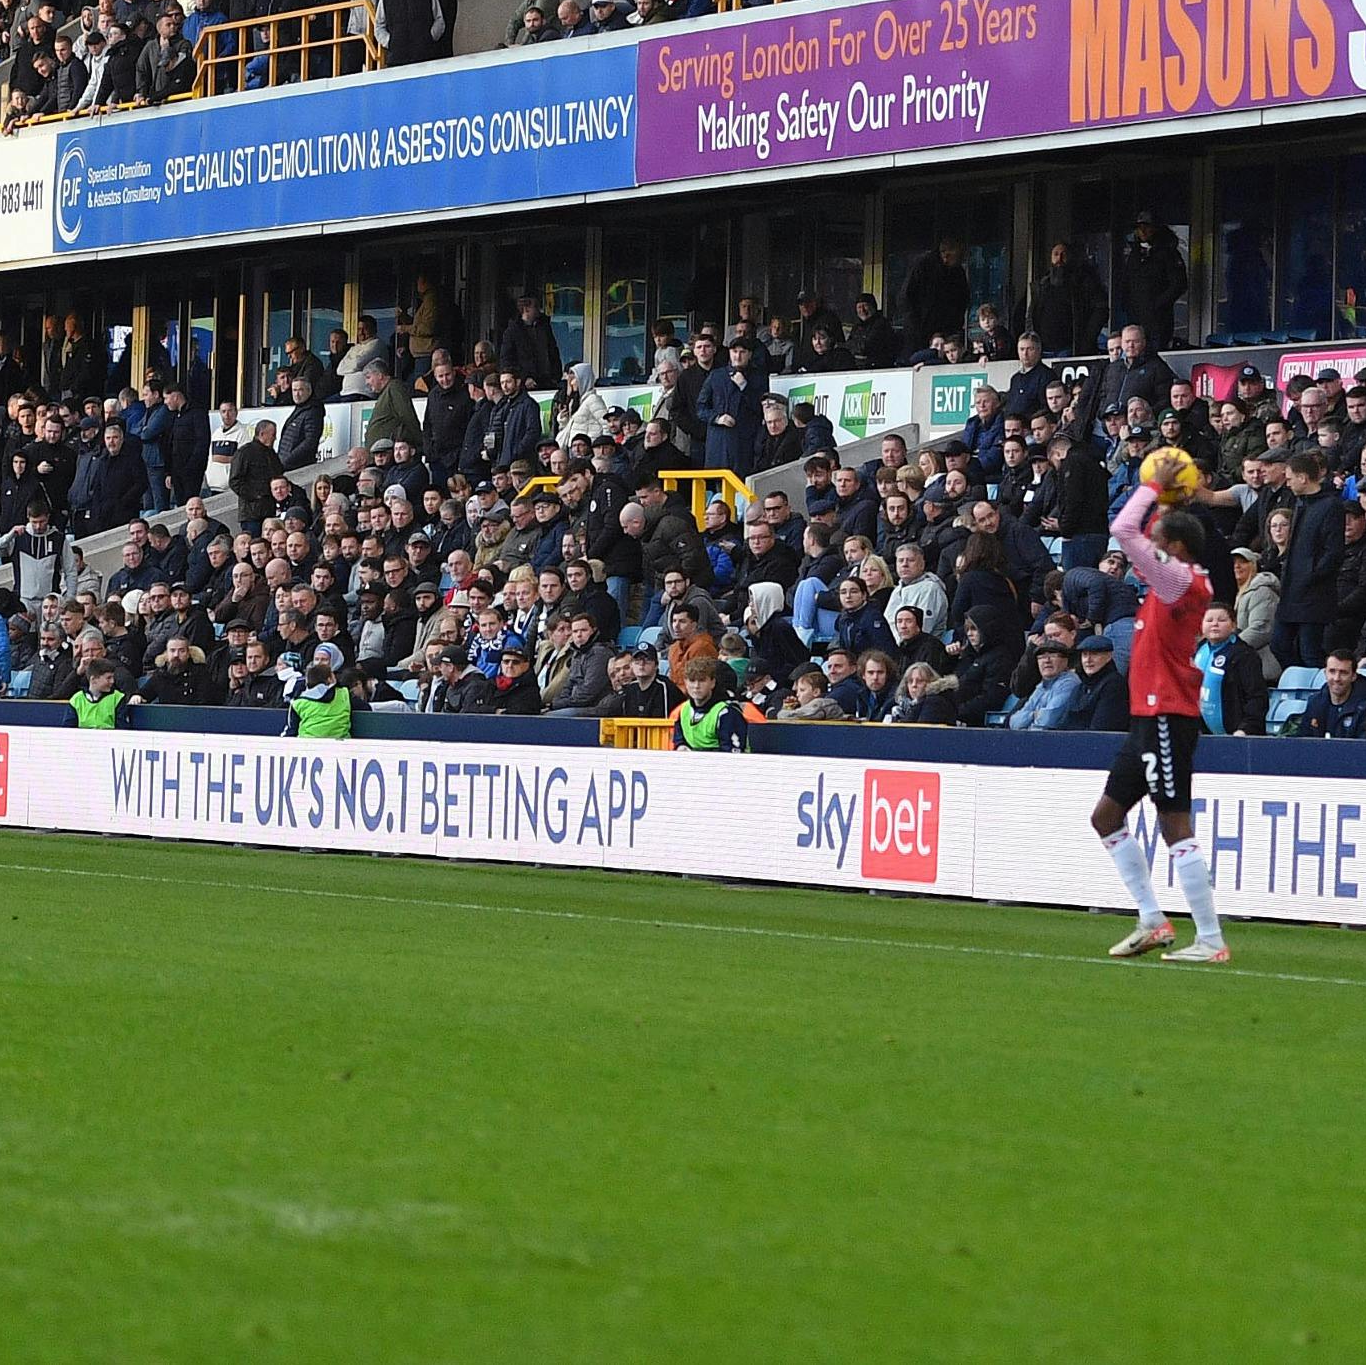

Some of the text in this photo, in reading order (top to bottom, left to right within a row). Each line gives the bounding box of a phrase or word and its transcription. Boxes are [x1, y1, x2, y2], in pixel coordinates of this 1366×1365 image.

[657, 42, 734, 99] Serving
[741, 24, 820, 82] London
[828, 19, 868, 68] For
[873, 9, 932, 62] Over
[165, 94, 633, 196] SPECIALIST DEMOLITION & ASBESTOS CONSULTANCY
[697, 69, 990, 160] Making Safety Our Priority
[23, 180, 44, 211] 4411
[62, 177, 82, 207] PJF
[87, 191, 93, 208] &
[870, 392, 887, 416] OUT
[934, 386, 966, 413] EXIT
[111, 747, 649, 848] WITH THE UK'S NO.1 BETTING APP
[797, 772, 932, 870] sky bet
[1262, 801, 1361, 899] THE
